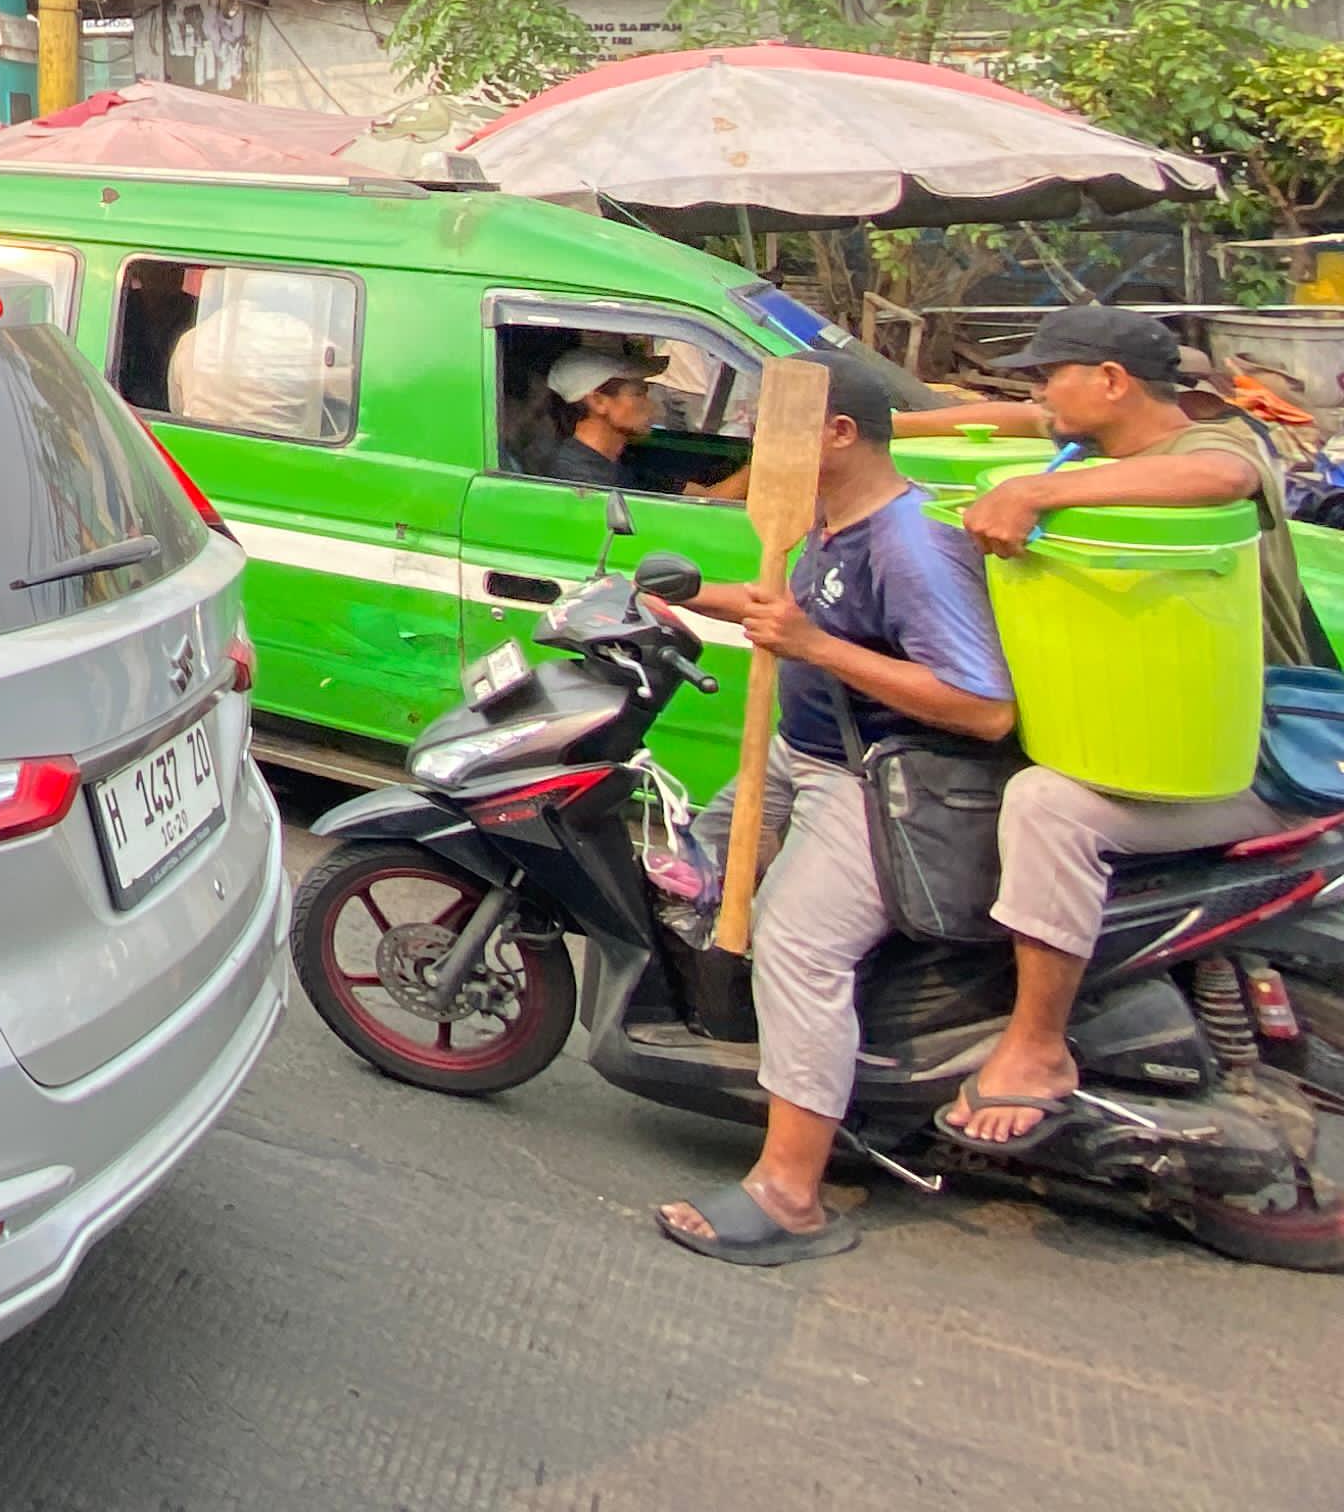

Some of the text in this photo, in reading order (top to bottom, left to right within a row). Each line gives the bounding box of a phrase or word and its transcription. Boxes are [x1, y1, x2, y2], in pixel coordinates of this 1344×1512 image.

[620, 23, 683, 32] SAMPAH
[105, 788, 128, 850] H
[136, 748, 182, 827] 1437
